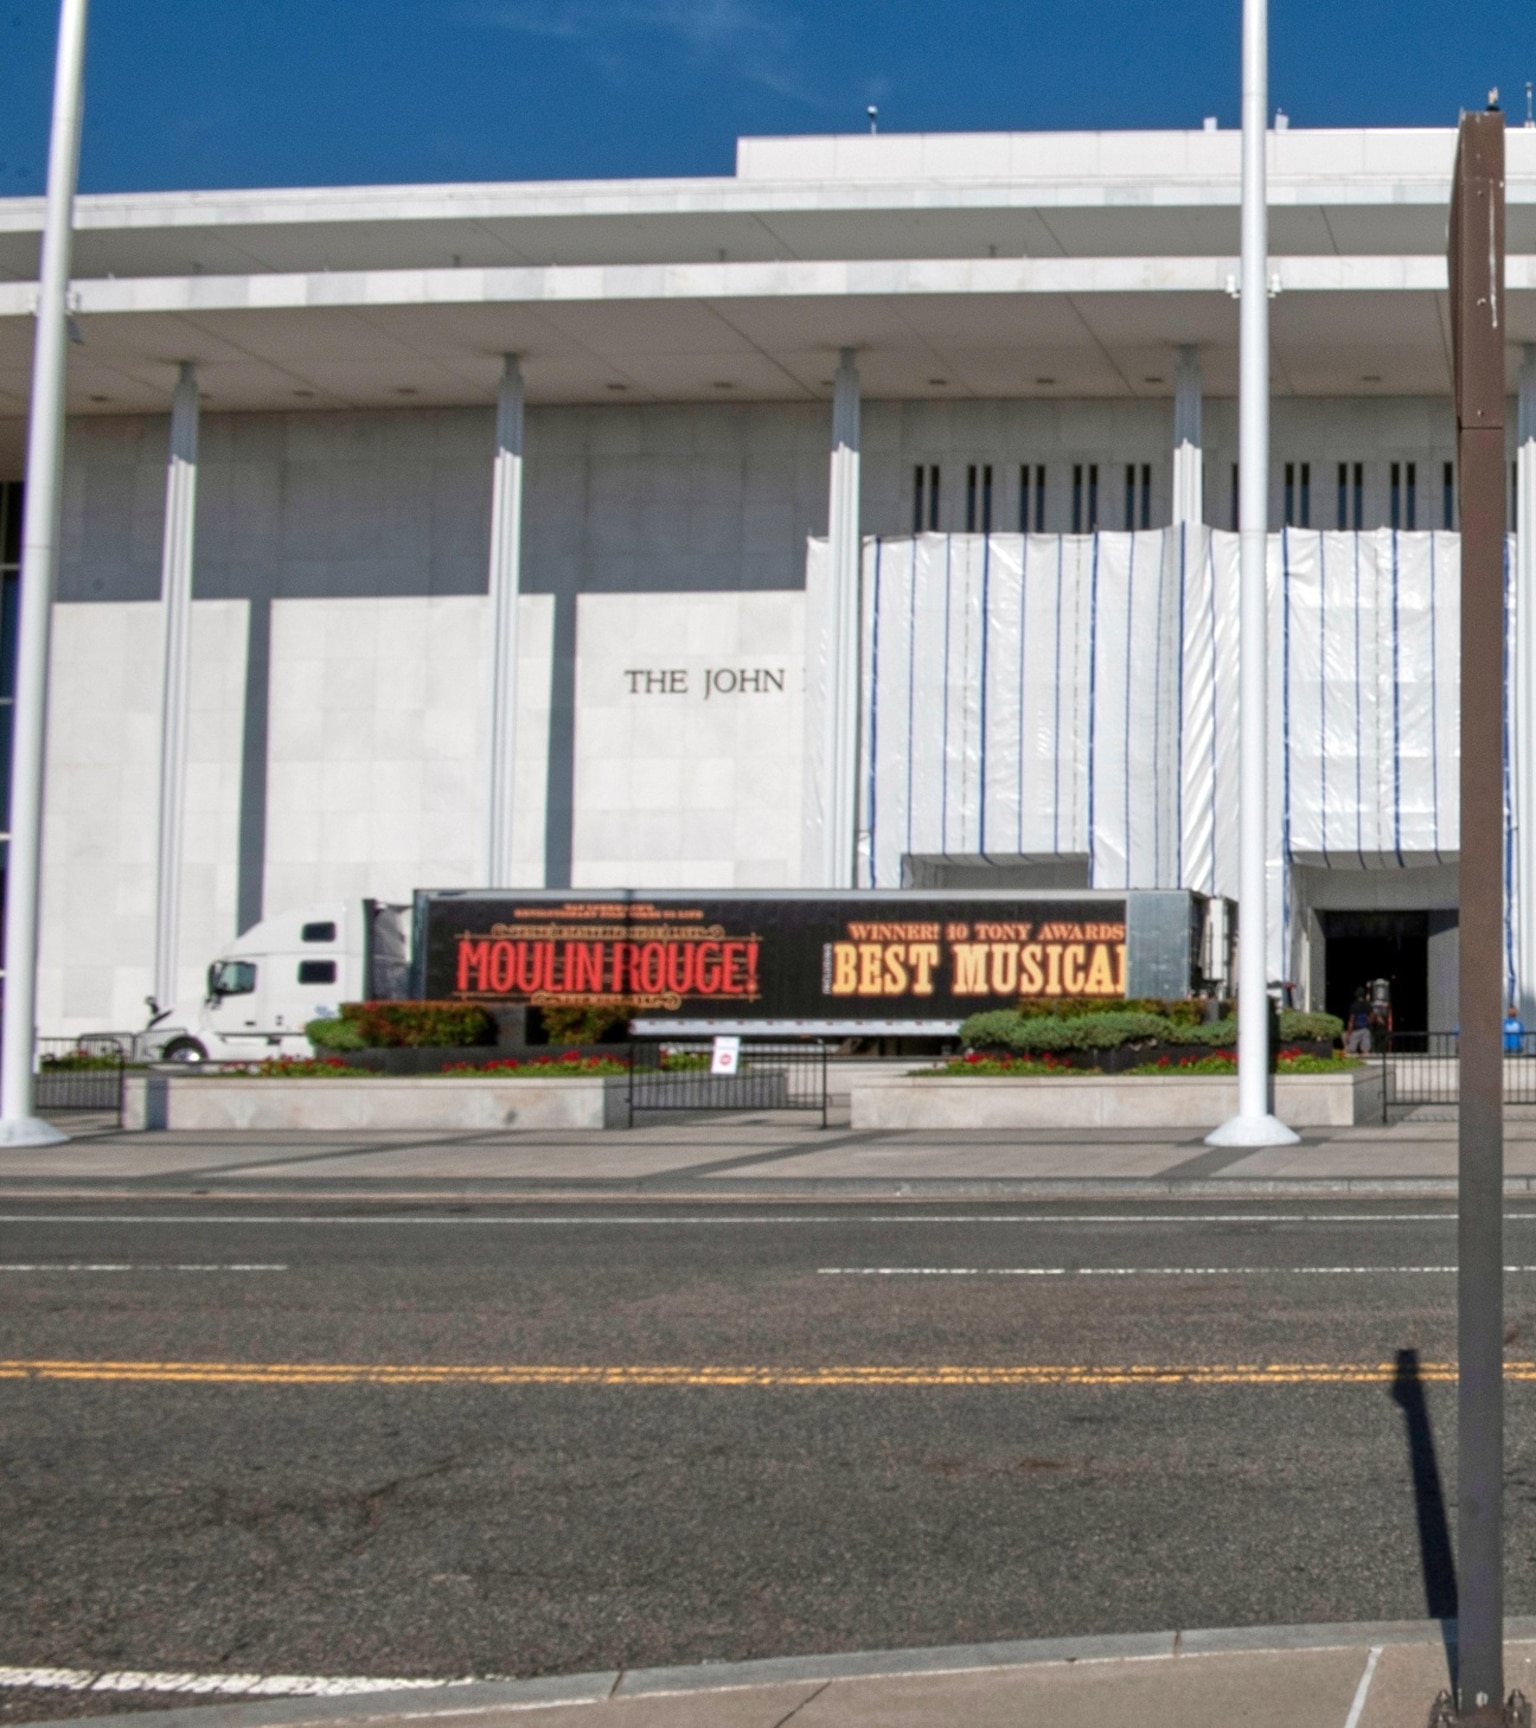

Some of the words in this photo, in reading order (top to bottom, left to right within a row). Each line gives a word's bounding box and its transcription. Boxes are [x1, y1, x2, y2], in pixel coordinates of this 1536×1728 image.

[624, 669, 688, 694] THE
[703, 668, 785, 701] JOHN
[847, 922, 940, 941] WINNER!
[945, 922, 969, 941] 10
[974, 922, 1032, 941] TONY
[1037, 922, 1126, 941] AWARDS
[456, 940, 604, 992] MOULIN
[611, 941, 759, 993] ROUGE!
[832, 942, 940, 997] BEST
